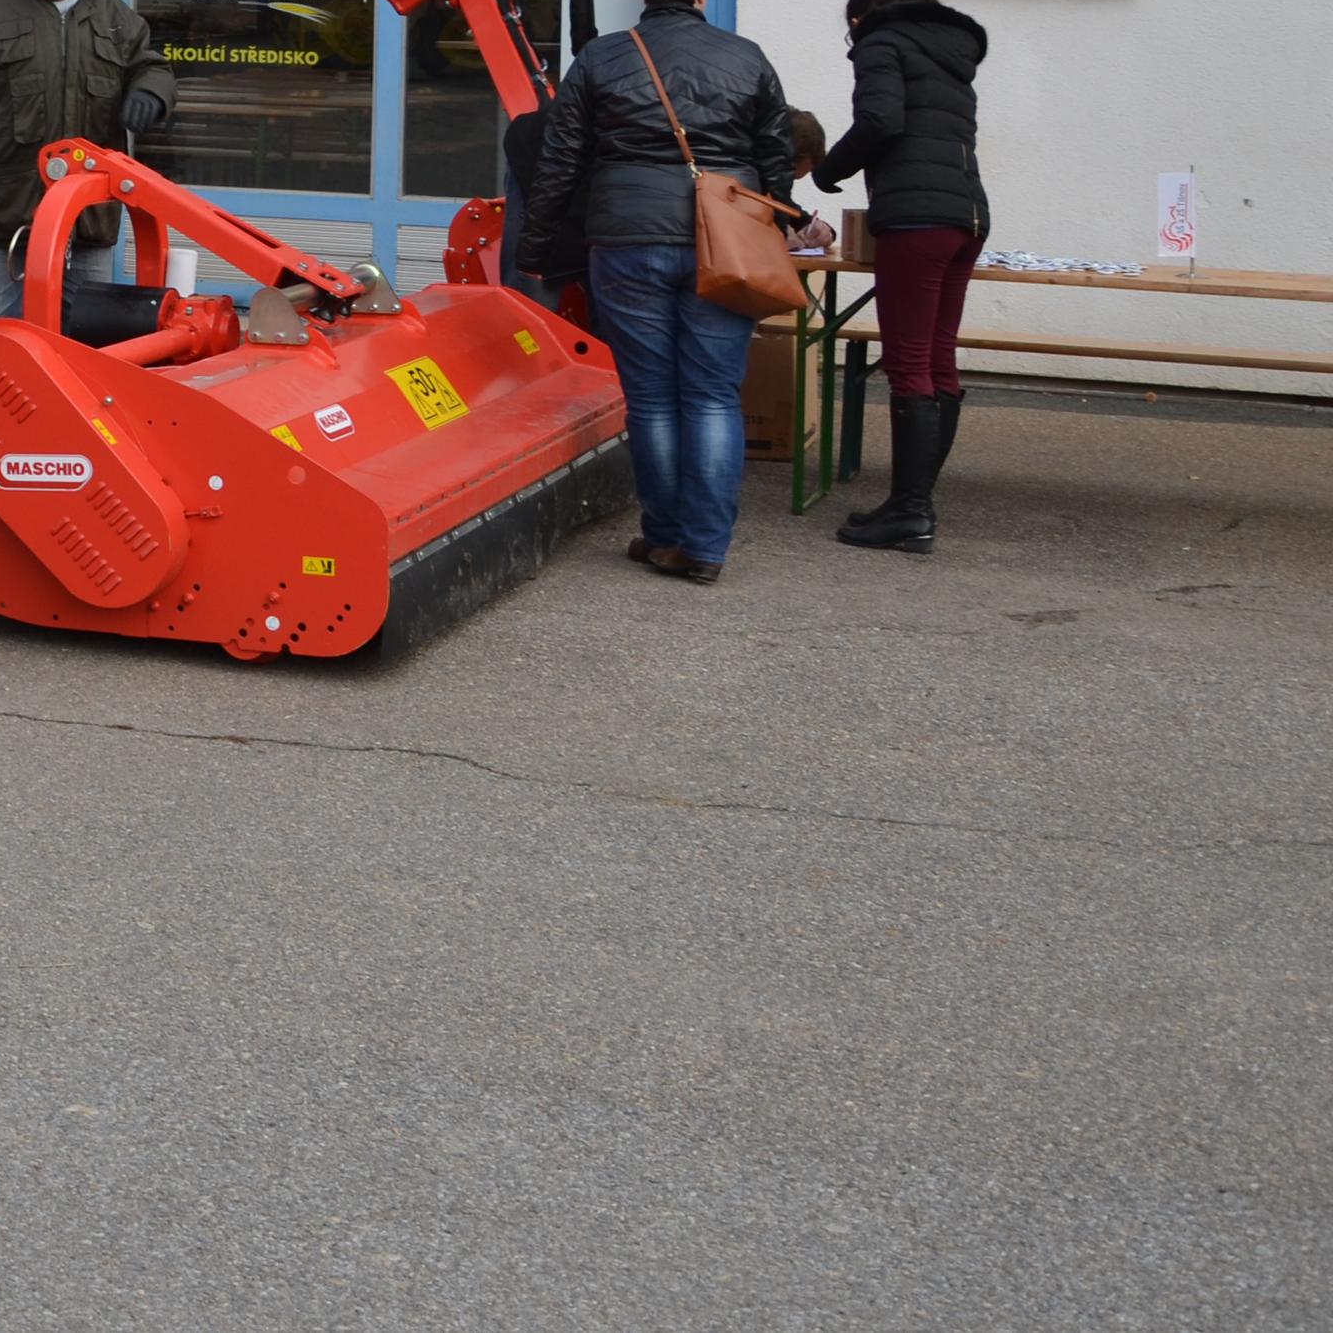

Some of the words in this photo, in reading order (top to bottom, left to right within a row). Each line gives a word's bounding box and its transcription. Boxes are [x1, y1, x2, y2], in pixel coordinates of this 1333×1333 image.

[163, 43, 227, 64] ŠKOLÍCÍ
[229, 45, 321, 66] STŘEDISKO
[407, 367, 437, 397] 50
[6, 462, 86, 477] MASCHIO
